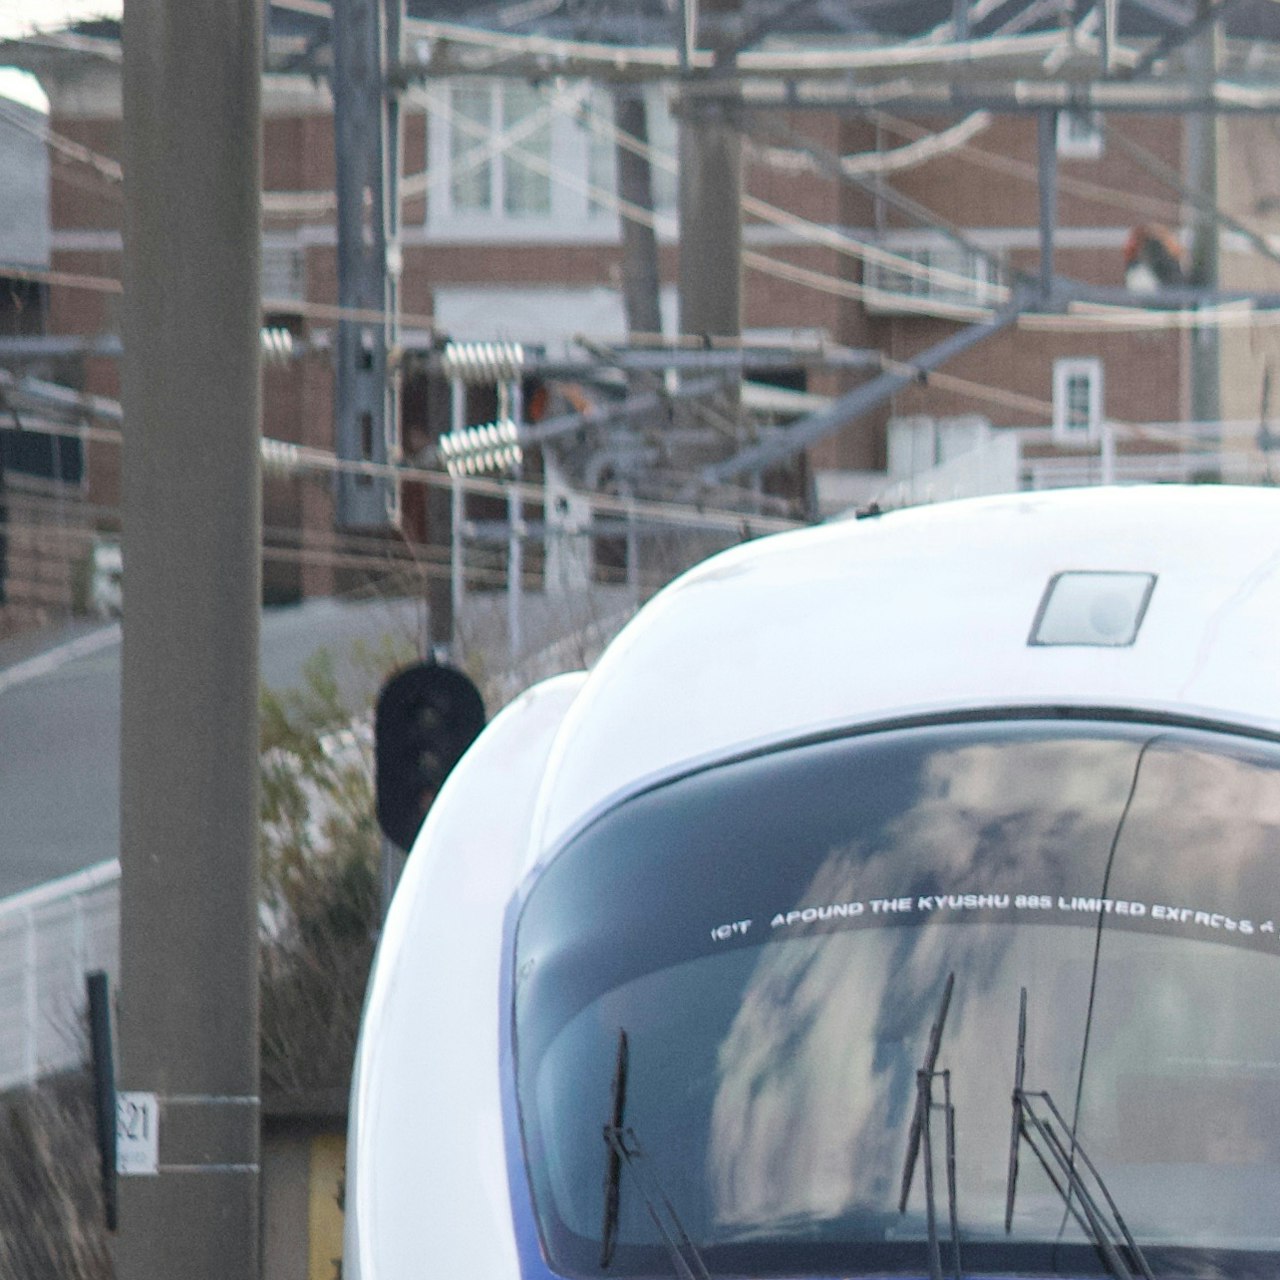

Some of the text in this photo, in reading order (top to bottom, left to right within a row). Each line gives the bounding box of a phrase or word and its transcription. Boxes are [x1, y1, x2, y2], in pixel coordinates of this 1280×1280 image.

[869, 898, 912, 914] THE
[917, 894, 1009, 911] KYUSHU
[1015, 894, 1052, 910] 885
[1058, 895, 1146, 917] LIMITED
